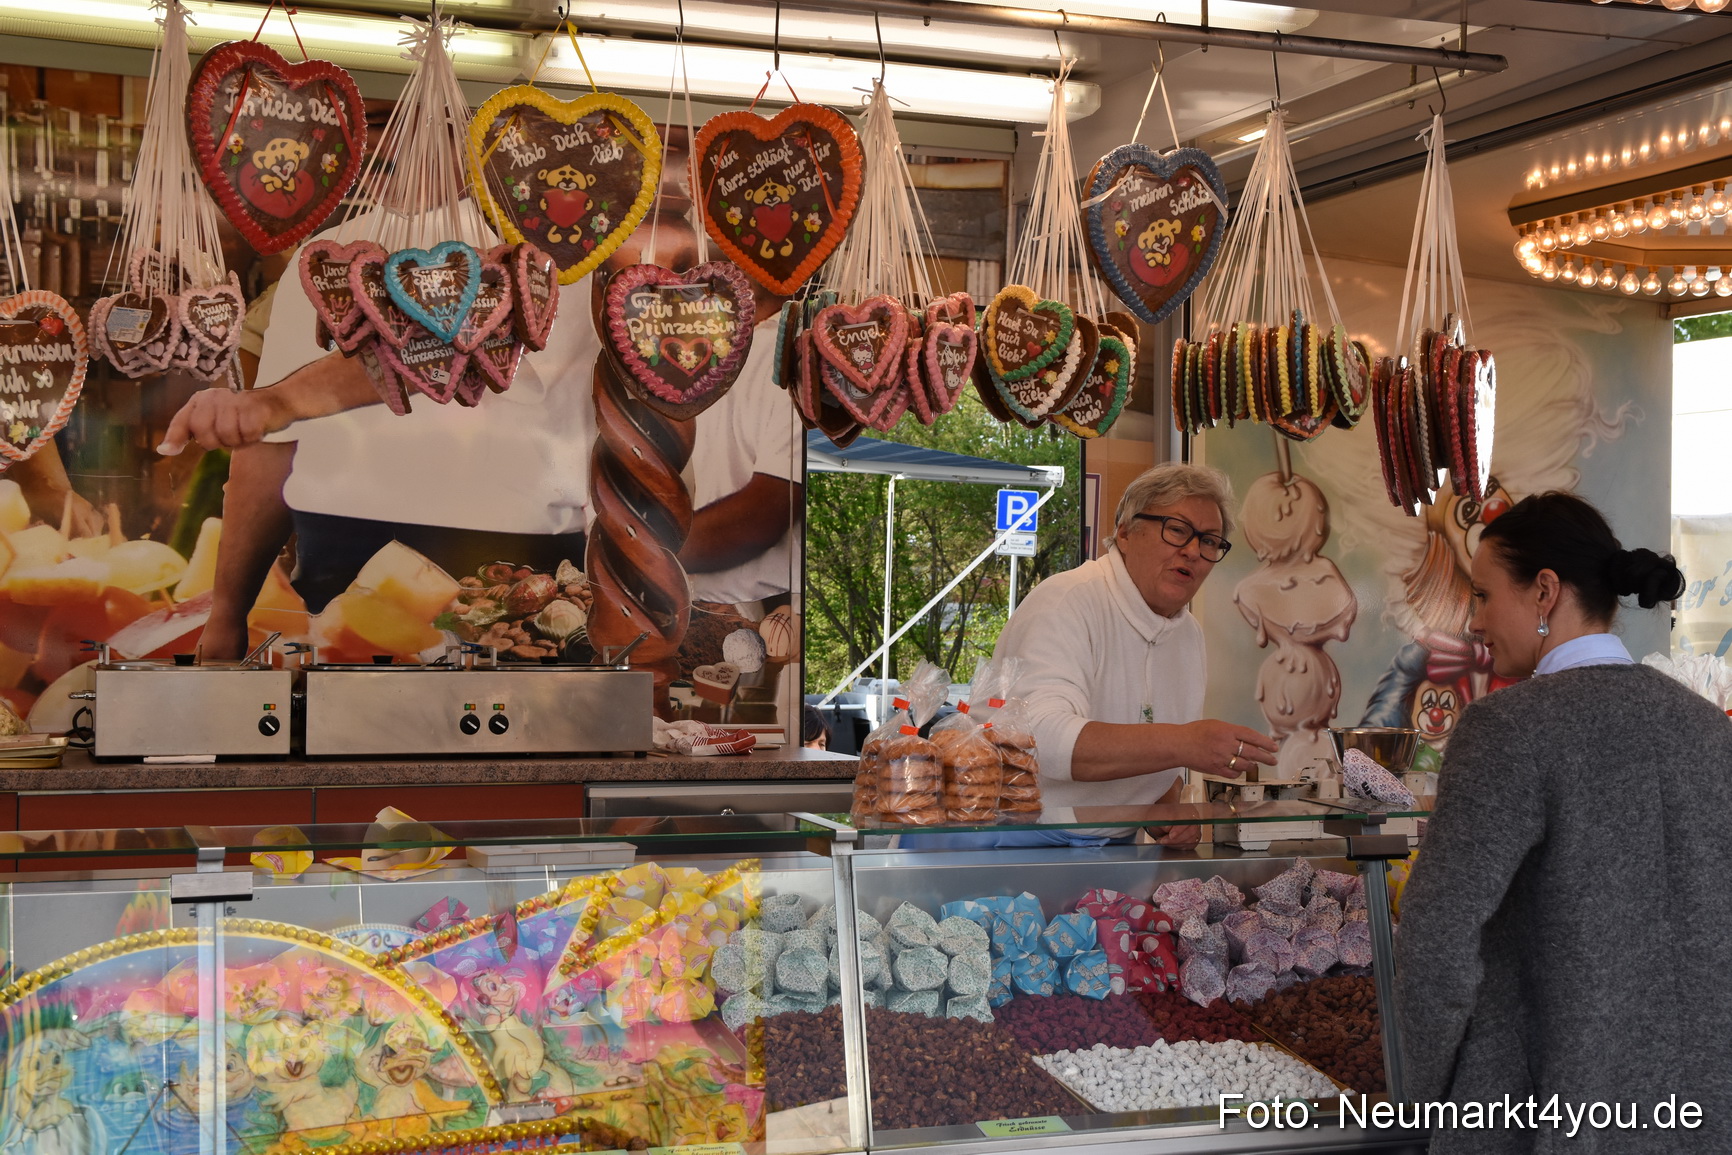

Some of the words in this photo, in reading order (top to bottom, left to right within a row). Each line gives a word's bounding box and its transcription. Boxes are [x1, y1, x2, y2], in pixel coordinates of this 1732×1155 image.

[551, 123, 593, 152] Dich
[510, 143, 546, 170] hab
[590, 140, 624, 166] lieb
[747, 136, 793, 179] schlägt
[782, 158, 807, 183] nur
[1116, 174, 1144, 197] Für
[1129, 183, 1173, 213] meinen
[411, 268, 457, 287] Süßer
[631, 292, 673, 319] Für
[679, 294, 736, 316] meine
[626, 317, 736, 342] Prinzessin
[837, 326, 882, 346] Engel
[997, 311, 1022, 333] Hast
[1023, 320, 1039, 338] Du
[997, 330, 1020, 347] mich
[998, 344, 1027, 363] lieb?
[1073, 399, 1105, 425] lieb?
[1006, 495, 1029, 526] P
